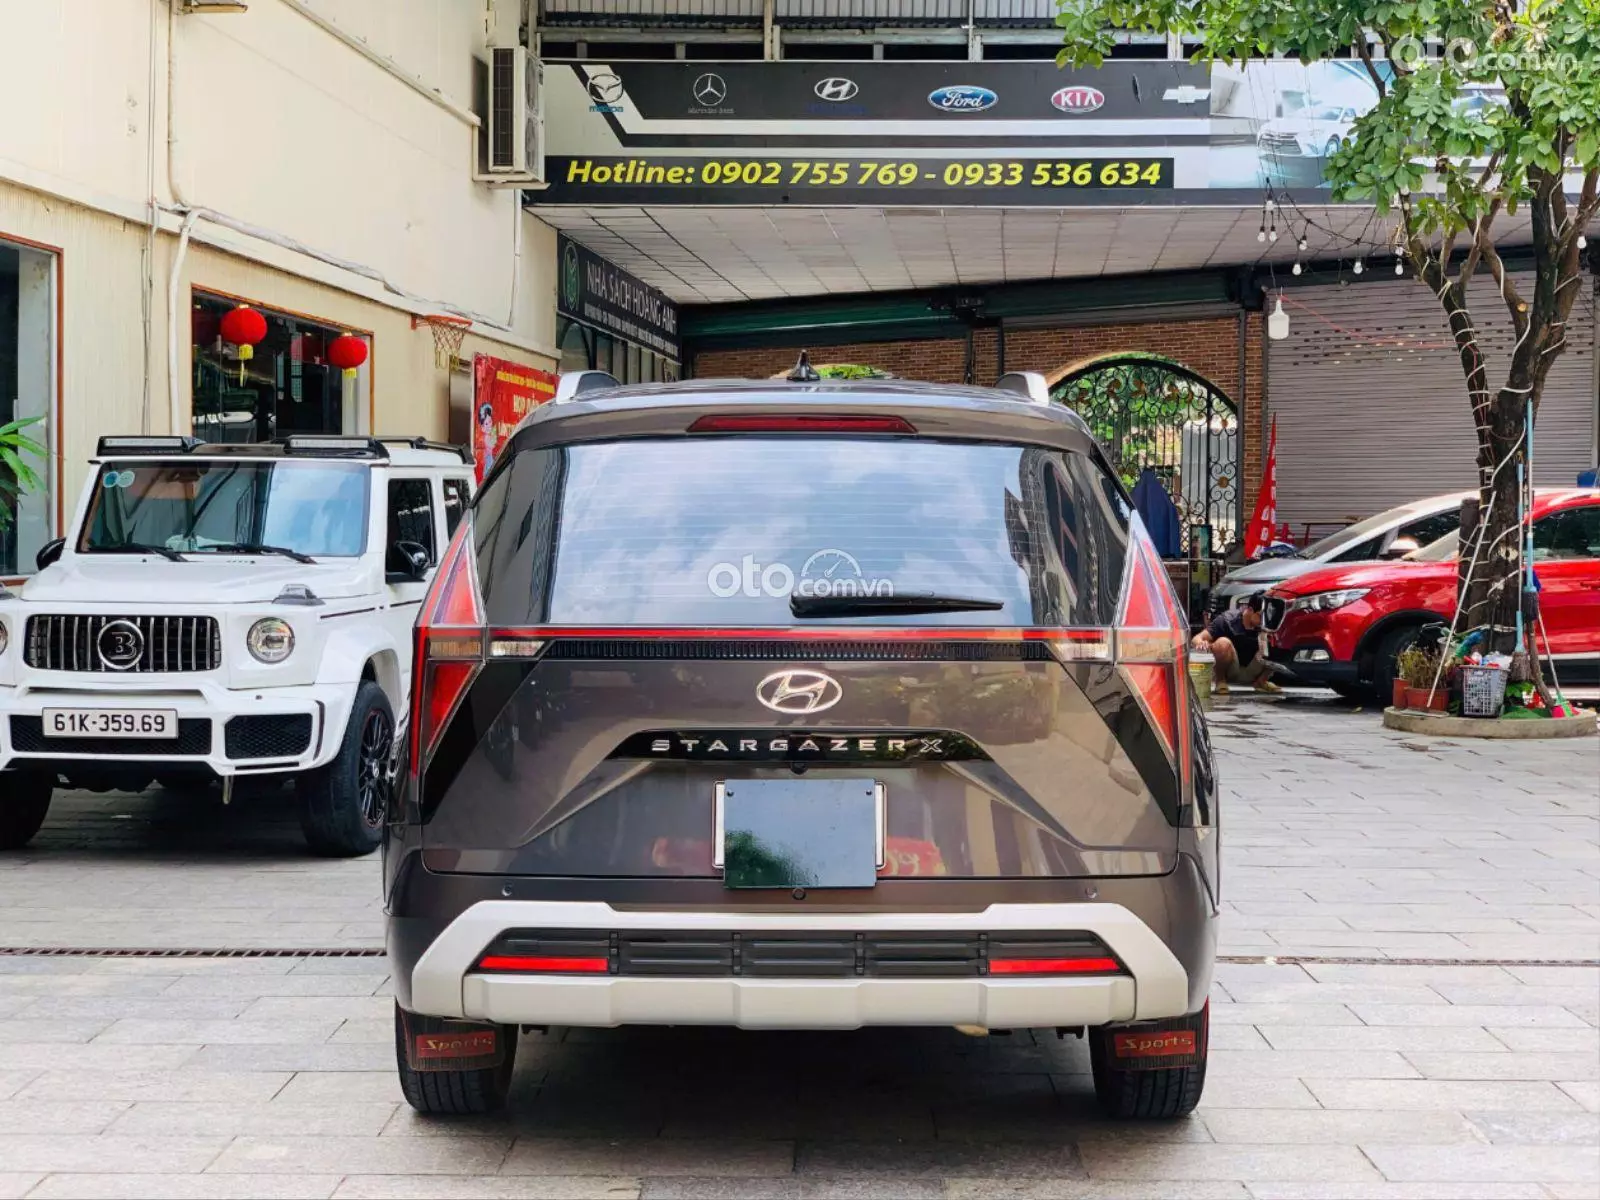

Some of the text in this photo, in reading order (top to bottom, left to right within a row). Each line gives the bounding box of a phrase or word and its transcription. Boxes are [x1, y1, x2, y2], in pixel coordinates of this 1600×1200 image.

[942, 89, 983, 108] Ford
[1060, 90, 1097, 106] KIA
[567, 160, 696, 185] Hotline:
[701, 161, 782, 185] 0902
[789, 162, 850, 185] 755
[857, 163, 919, 186] 769
[943, 163, 1024, 186] 0933
[1031, 163, 1092, 186] 536
[1099, 163, 1161, 186] 634
[53, 713, 166, 733] 61K-359.69
